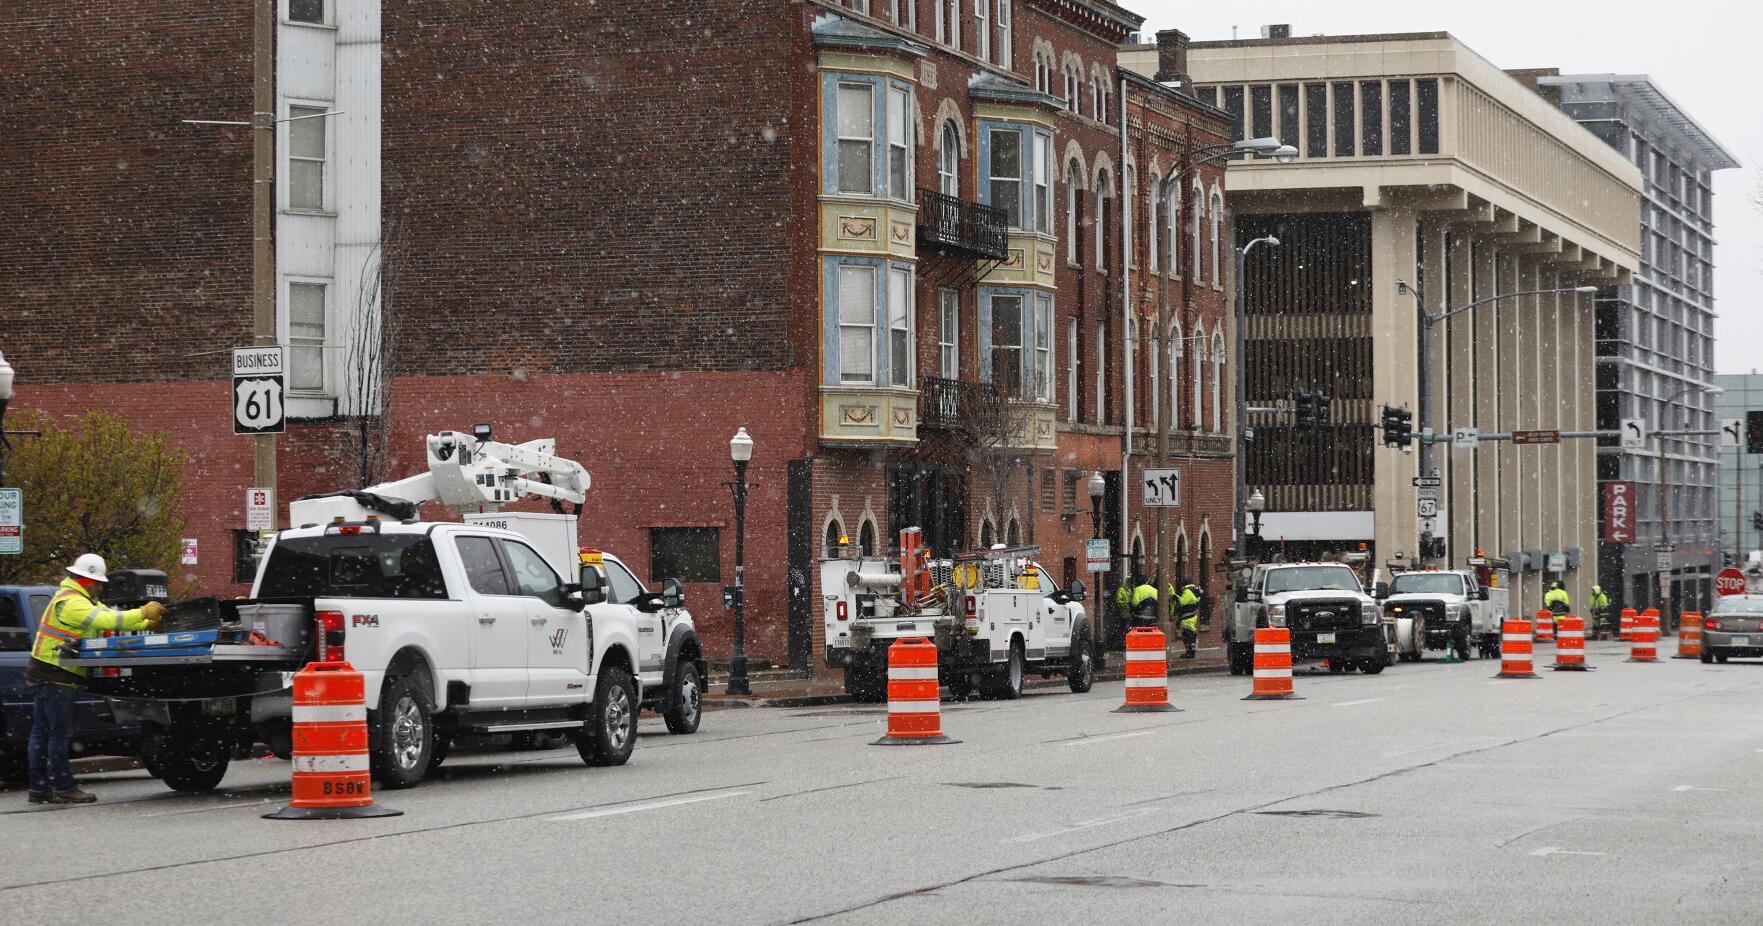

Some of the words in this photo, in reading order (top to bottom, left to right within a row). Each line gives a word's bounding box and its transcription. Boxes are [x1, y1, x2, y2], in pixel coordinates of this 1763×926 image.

[237, 353, 279, 368] BUSINESS
[246, 389, 271, 420] 61
[1421, 502, 1434, 514] 67
[1613, 484, 1628, 529] PARK
[1716, 577, 1744, 591] STOP
[351, 614, 379, 627] FX4
